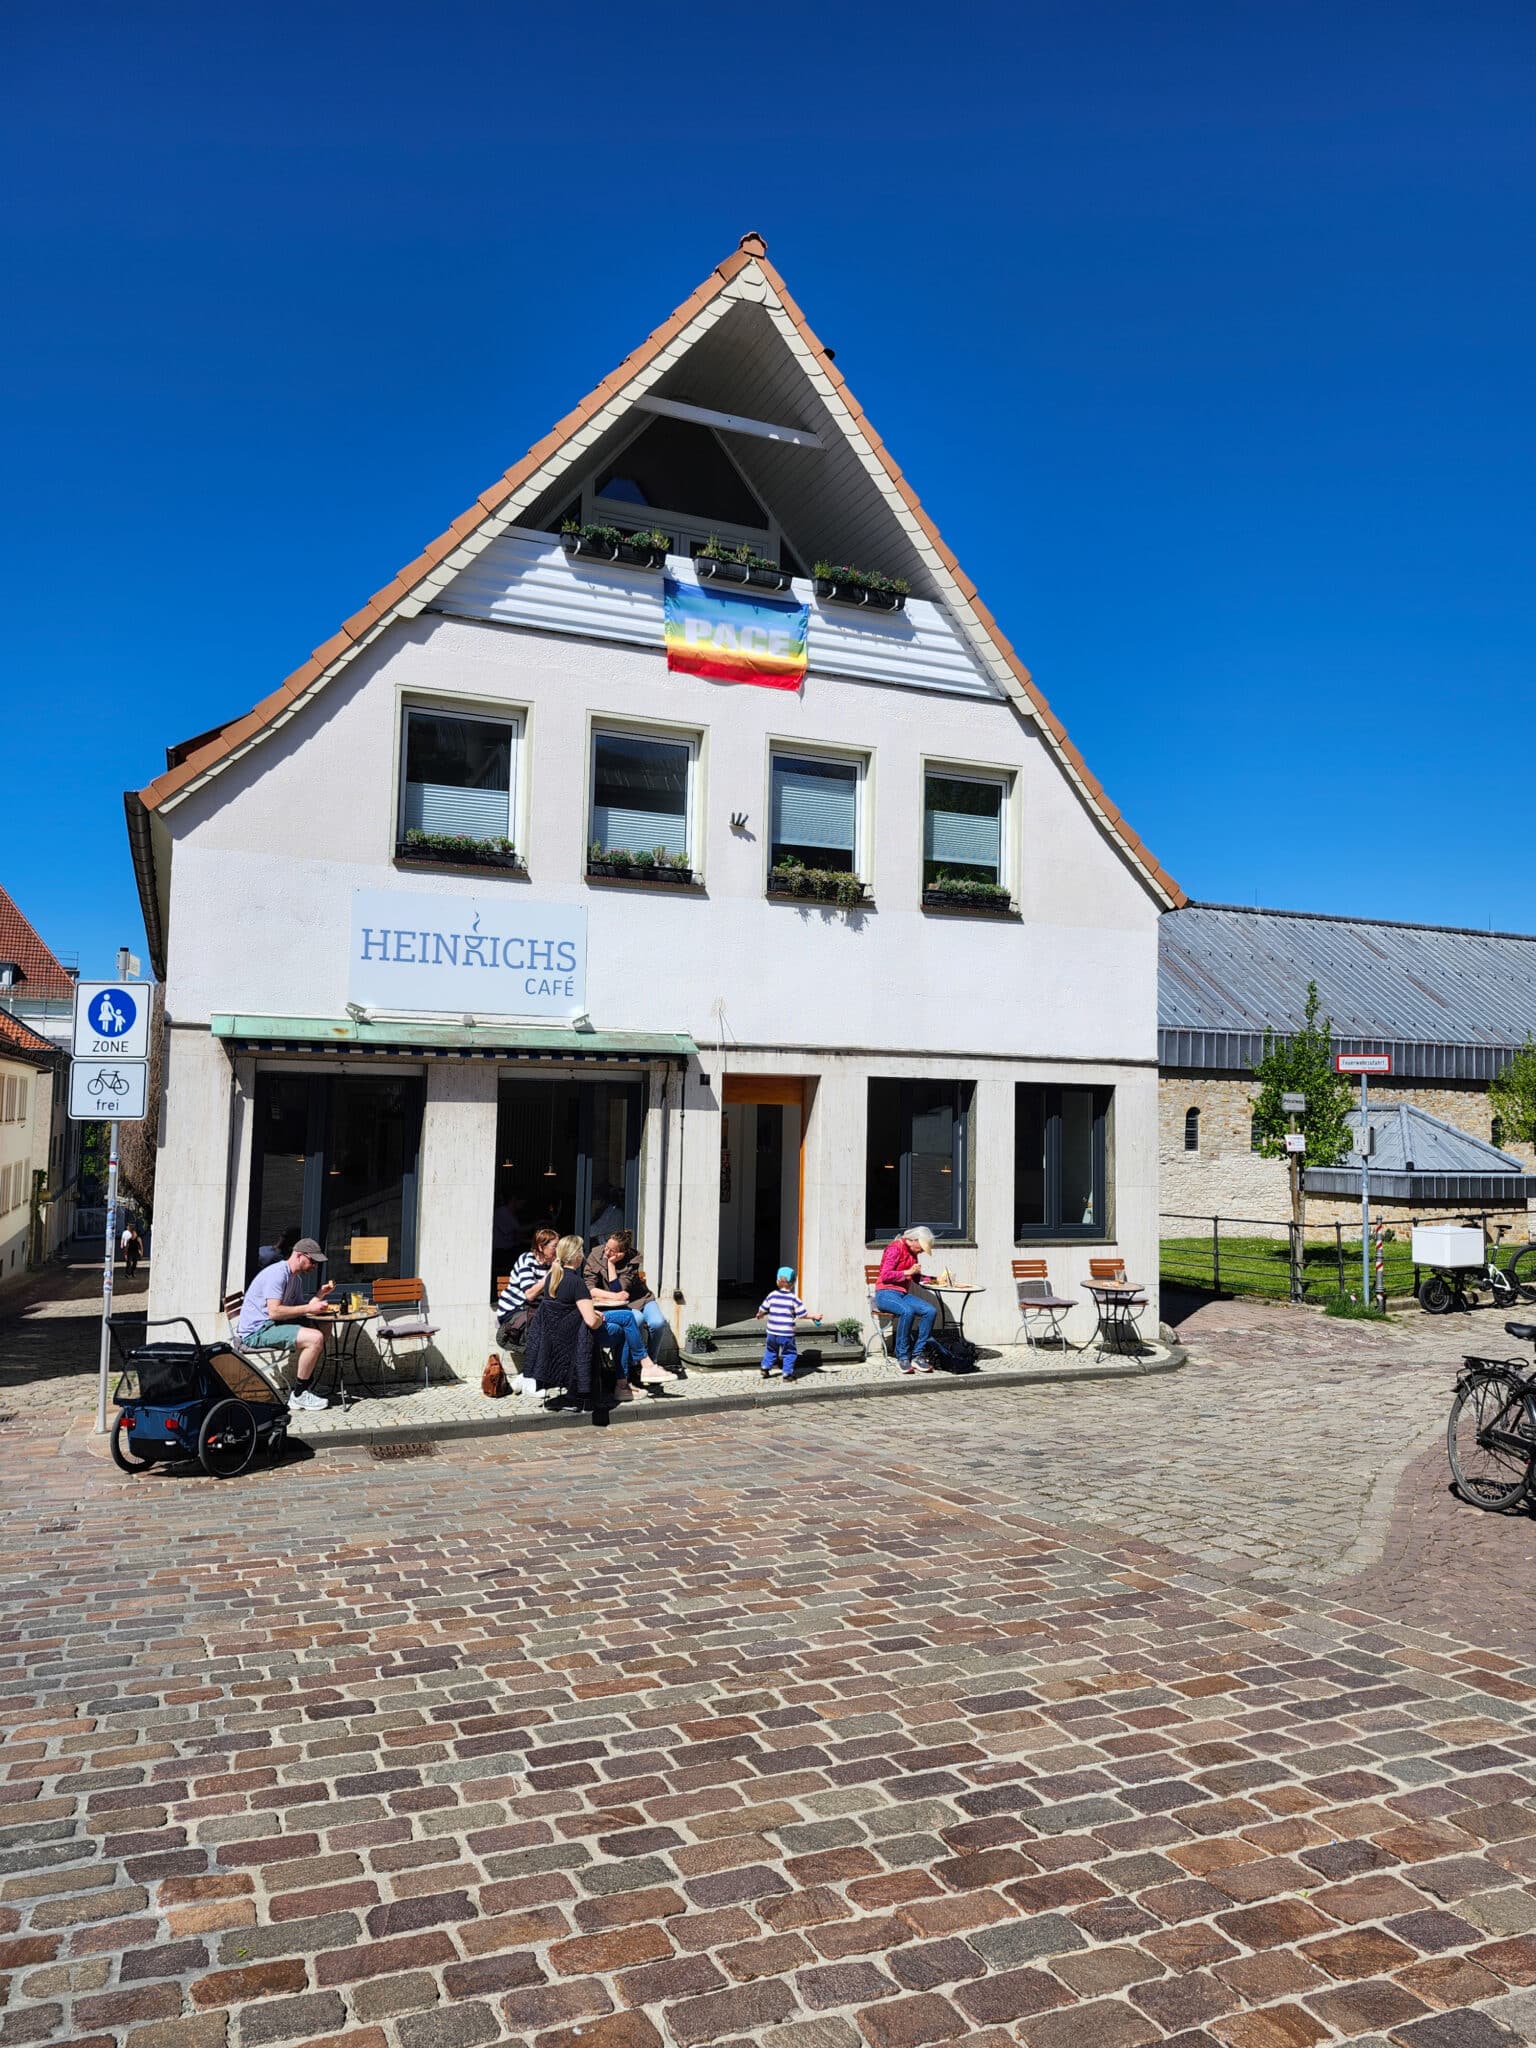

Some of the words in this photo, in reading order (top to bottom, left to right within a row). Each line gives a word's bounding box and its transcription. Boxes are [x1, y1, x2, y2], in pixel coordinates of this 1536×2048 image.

[685, 618, 790, 657] PACE
[361, 928, 577, 972] HEINRICHS
[525, 976, 574, 997] CAFÉ
[92, 1041, 129, 1053] ZONE
[96, 1099, 119, 1111] frei
